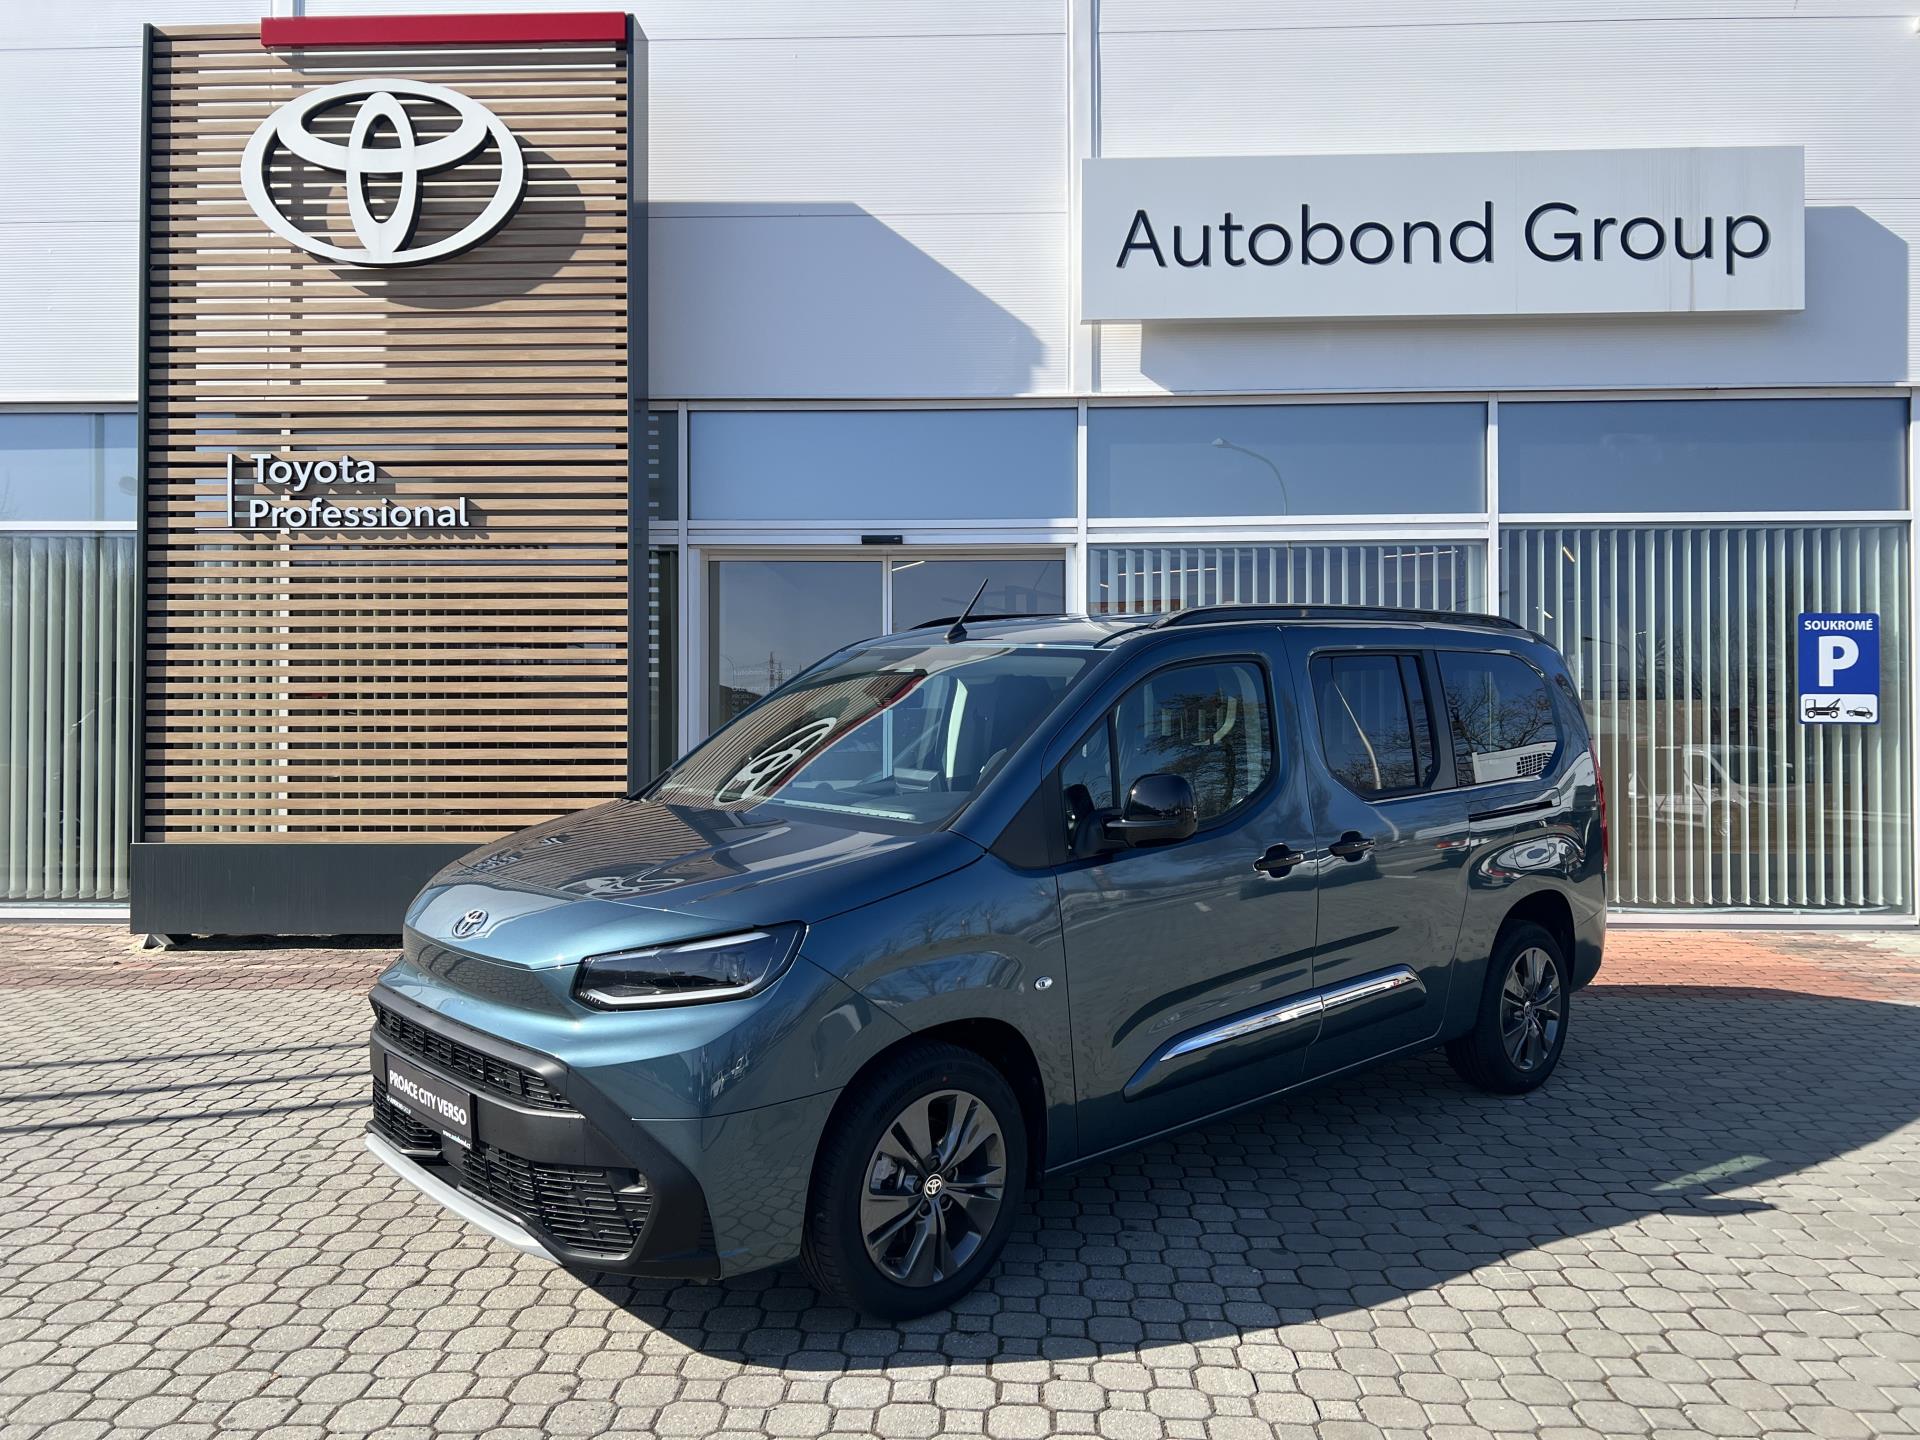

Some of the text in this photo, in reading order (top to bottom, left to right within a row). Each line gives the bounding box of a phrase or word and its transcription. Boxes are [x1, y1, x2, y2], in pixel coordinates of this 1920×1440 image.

[1117, 201, 1771, 276] Autobond Group
[250, 453, 376, 492] Toyota
[250, 496, 470, 528] Professional
[1804, 619, 1874, 631] SOUKROMÉ
[1818, 635, 1860, 687] P
[389, 1069, 418, 1100] PROACE
[418, 1087, 437, 1110] CITY
[437, 1097, 467, 1126] VERSO
